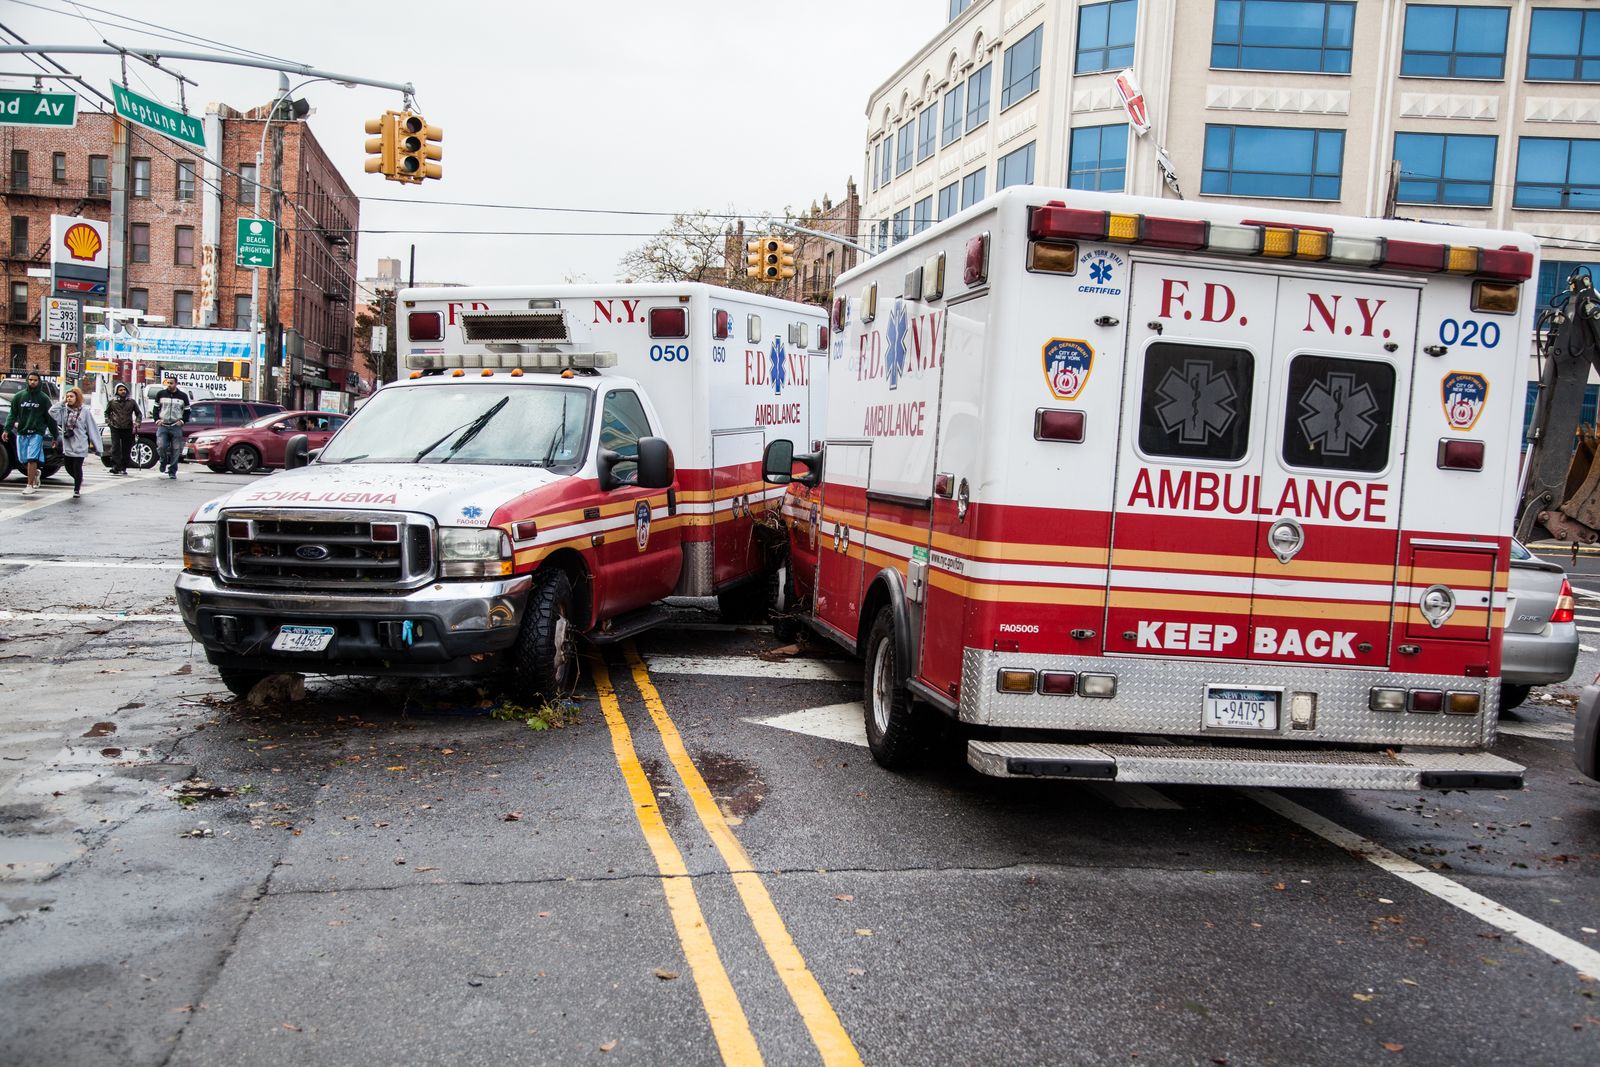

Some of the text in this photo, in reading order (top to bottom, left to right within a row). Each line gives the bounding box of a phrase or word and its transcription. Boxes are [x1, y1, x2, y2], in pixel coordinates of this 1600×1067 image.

[34, 97, 65, 117] Av
[120, 92, 196, 138] Neptune Av
[246, 236, 266, 244] BEACH
[241, 246, 271, 255] BRIGHTON
[1078, 286, 1121, 295] CERTIFIED
[60, 311, 74, 320] 393
[592, 300, 645, 324] N.Y.
[1158, 278, 1391, 338] F.D. N.Y.
[60, 321, 74, 331] 413
[1439, 318, 1501, 349] 020
[60, 332, 74, 341] 427
[650, 345, 689, 362] 050
[712, 346, 726, 362] 050
[744, 350, 808, 386] F.D. N.Y.
[205, 383, 227, 391] HOURS
[755, 403, 801, 426] AMBULANCE
[863, 401, 926, 436] AMBULANCE
[1127, 467, 1389, 523] AMBULANCE
[999, 623, 1039, 634] FA05005
[1136, 620, 1358, 659] KEEP BACK
